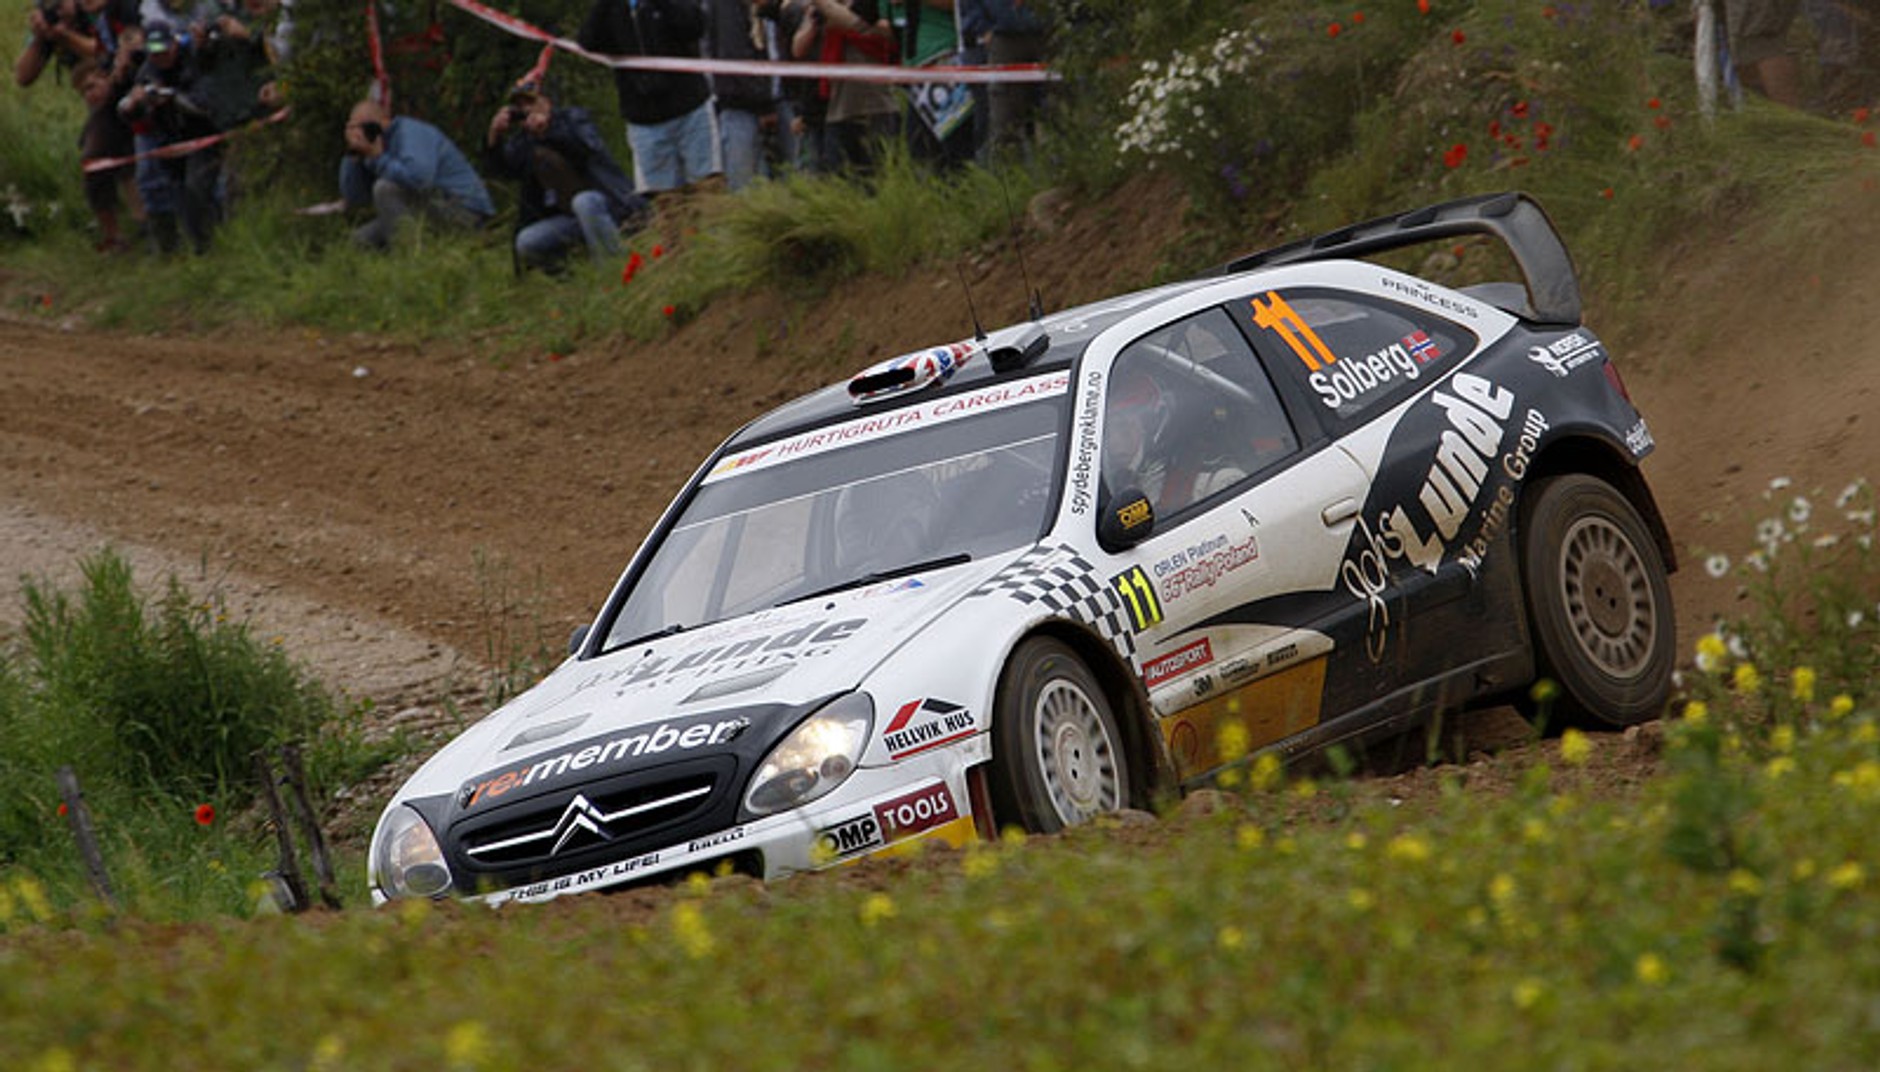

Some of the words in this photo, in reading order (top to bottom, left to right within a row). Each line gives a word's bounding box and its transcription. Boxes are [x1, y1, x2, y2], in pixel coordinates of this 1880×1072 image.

[1382, 277, 1478, 318] PRINCESS
[1250, 290, 1336, 372] 11
[1310, 342, 1421, 408] Solberg
[778, 411, 922, 456] HURTIGRUTA
[933, 376, 1069, 416] CARGLASS
[1071, 371, 1102, 515] spydebergreklame.no
[1387, 372, 1515, 576] Lunde
[1457, 486, 1515, 580] Marine
[1503, 407, 1550, 481] Group
[1119, 501, 1151, 528] OMP
[1154, 550, 1188, 577] ORLEN
[1186, 533, 1229, 561] Platinum
[1117, 566, 1162, 630] 11
[1151, 643, 1207, 679] AUTOSPORT
[1193, 674, 1213, 697] 3M
[884, 726, 943, 752] HELLVIK
[944, 710, 975, 731] HUS
[884, 792, 949, 830] TOOLS
[508, 883, 549, 900] THIS
[554, 876, 573, 891] IS
[577, 868, 608, 885] MY
[613, 853, 661, 876] LIFE!
